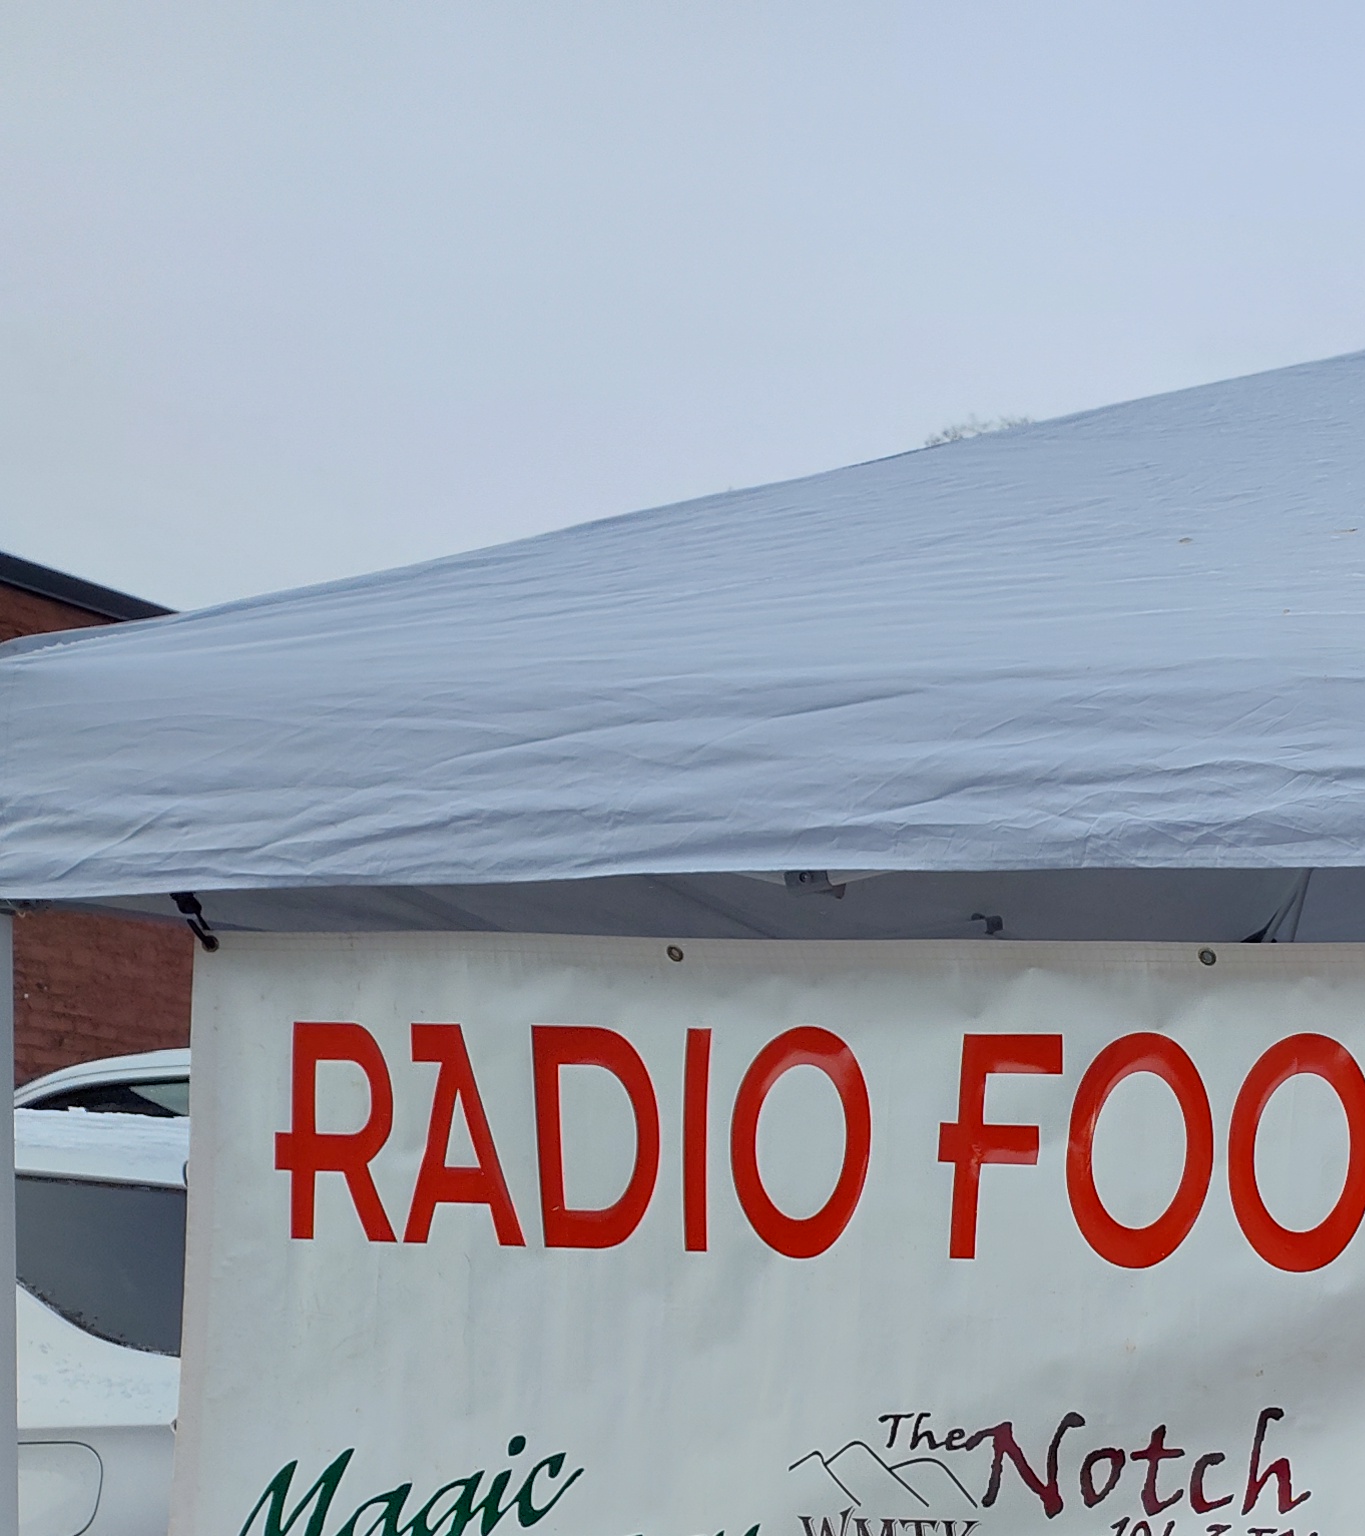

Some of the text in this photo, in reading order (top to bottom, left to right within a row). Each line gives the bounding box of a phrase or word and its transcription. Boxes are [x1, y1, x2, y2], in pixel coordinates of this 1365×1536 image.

[275, 1021, 871, 1259] RADIO
[878, 1407, 1311, 1519] The Notch
